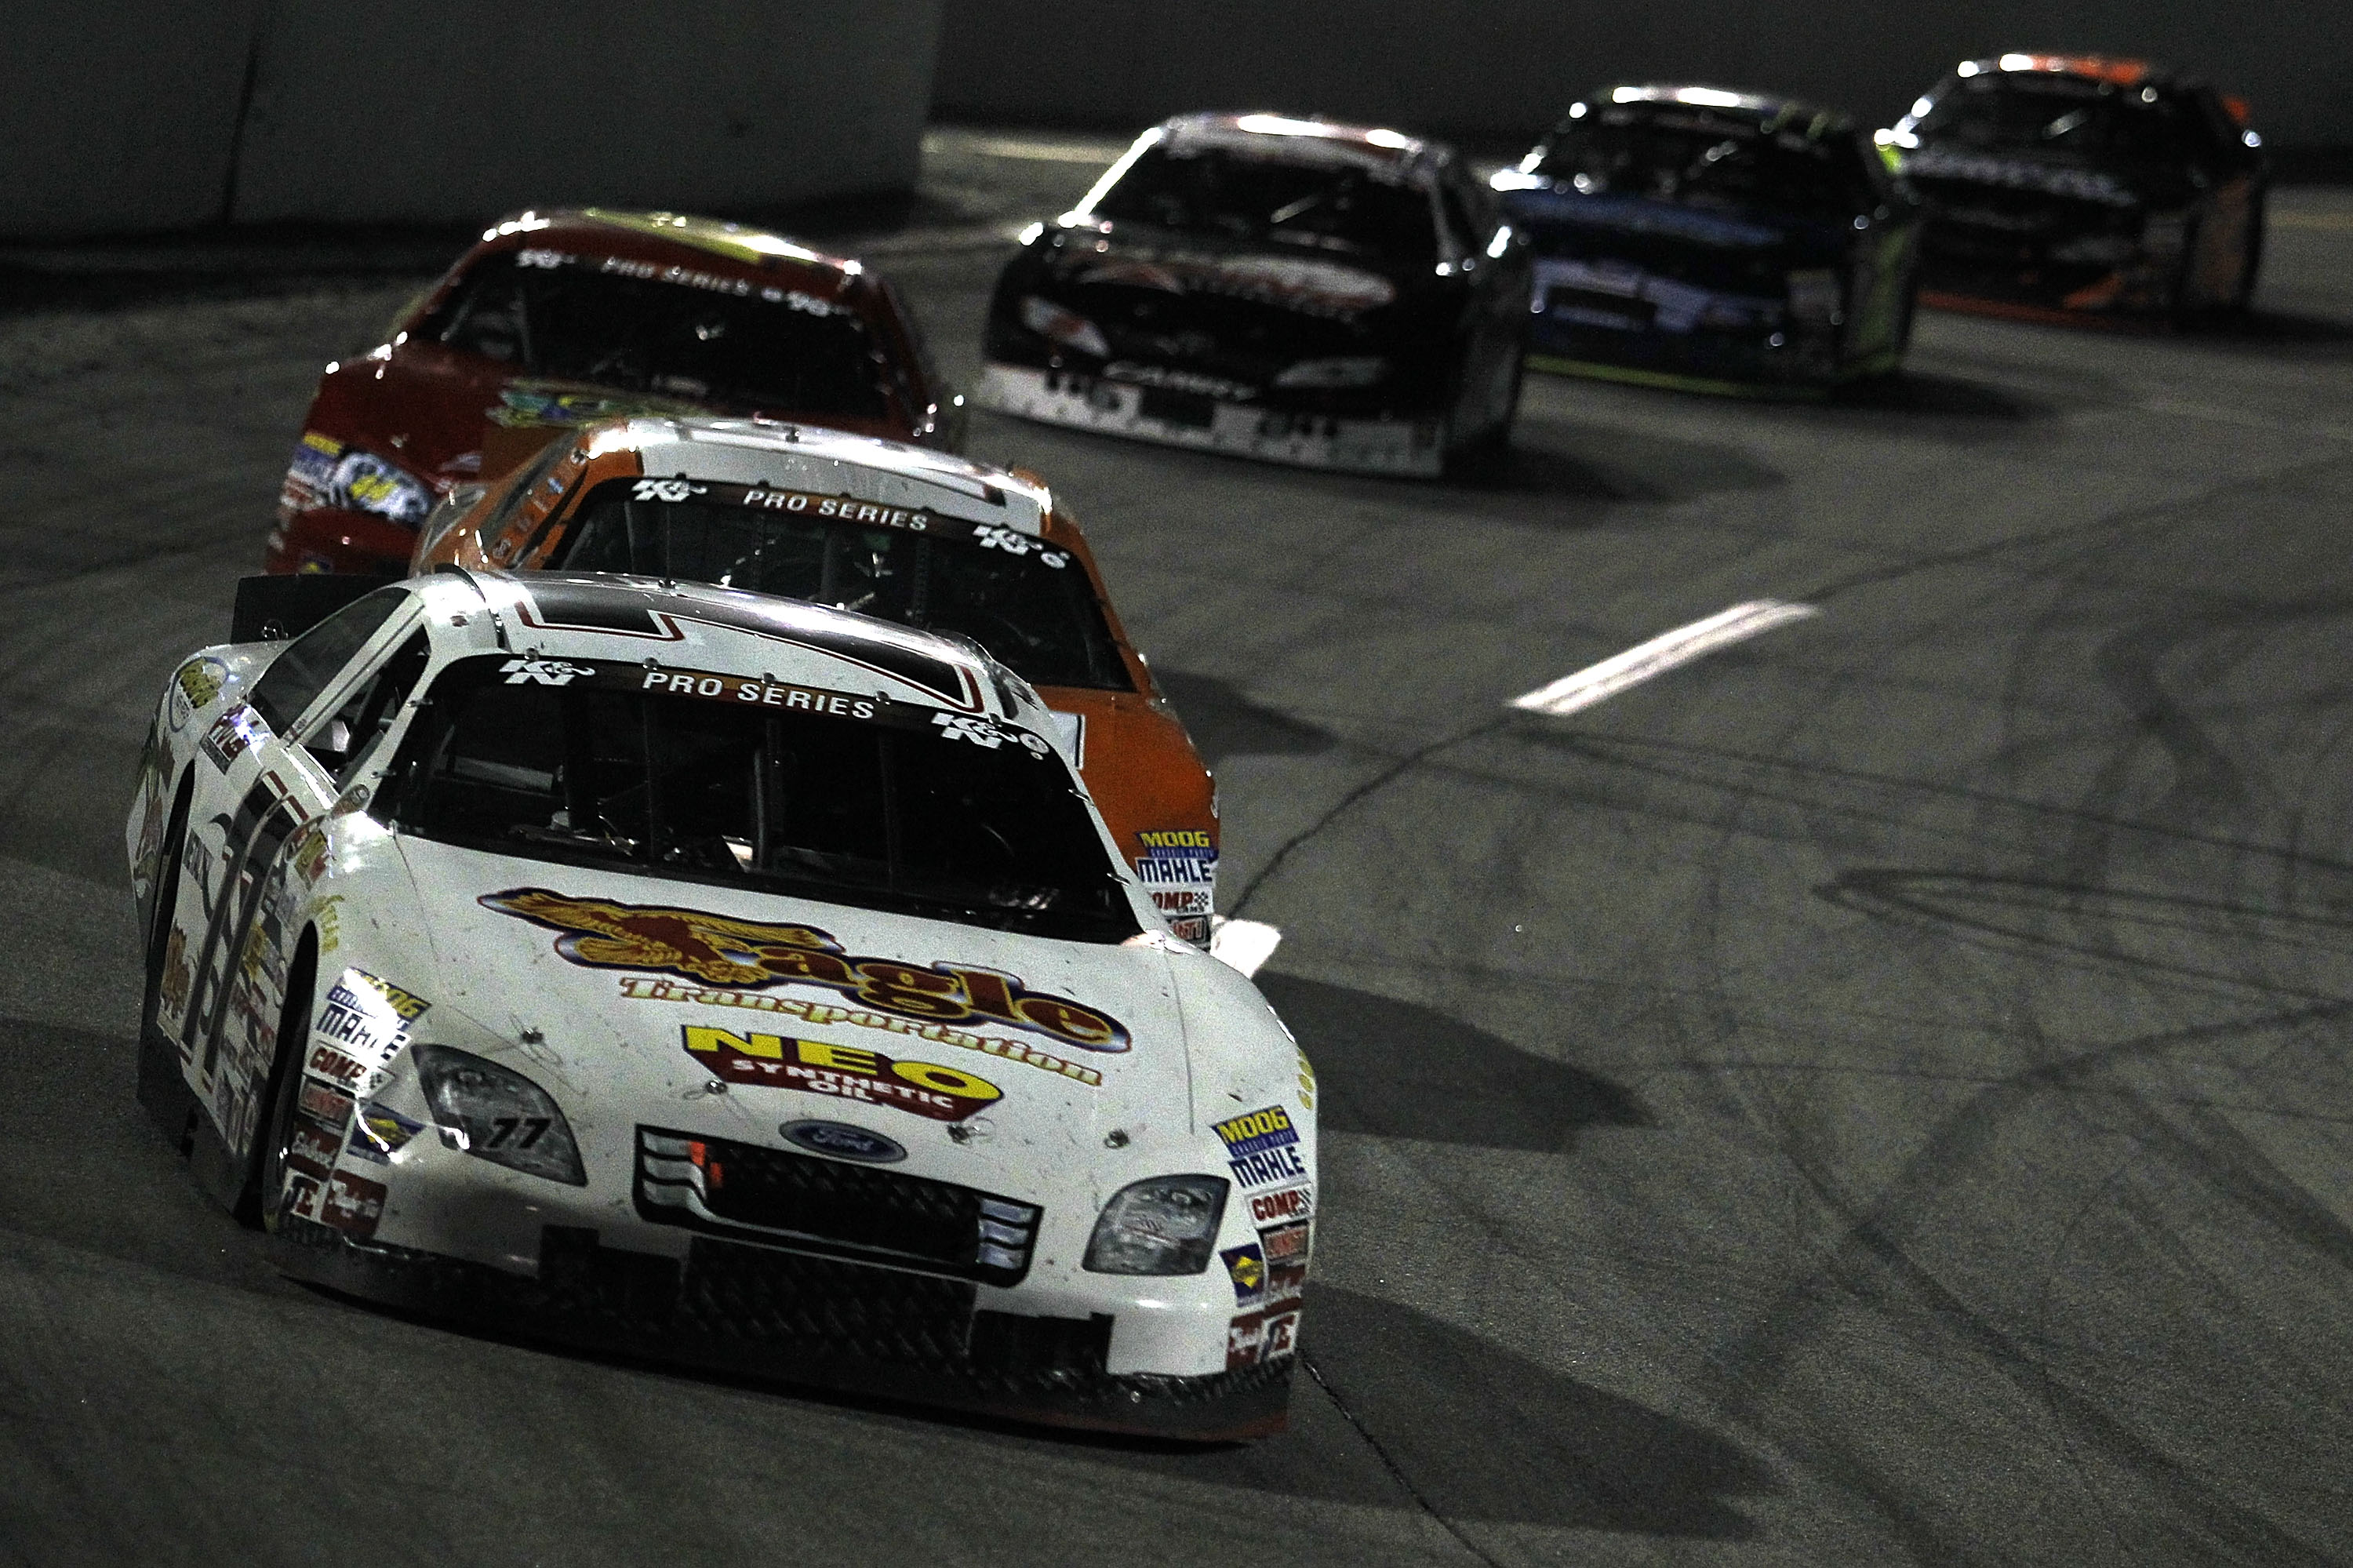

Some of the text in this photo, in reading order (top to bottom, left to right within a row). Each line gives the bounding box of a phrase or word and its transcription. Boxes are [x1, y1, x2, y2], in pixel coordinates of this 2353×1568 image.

[662, 265, 749, 297] SERIES
[743, 489, 929, 533] PRO SERIES
[642, 671, 876, 721] PRO SERIES
[1140, 831, 1210, 849] MOOG
[1136, 858, 1213, 883] MAHLE
[1151, 890, 1195, 911] OMP
[619, 977, 1103, 1086] Transportation
[310, 1047, 367, 1078] COMP
[684, 1025, 1002, 1100] NEO
[731, 1059, 955, 1109] SYNTHETIC
[807, 1079, 875, 1102] OIL
[488, 1118, 551, 1148] 77
[1218, 1107, 1289, 1144] MOOG
[1228, 1145, 1307, 1188] MAHLE
[1251, 1189, 1300, 1221] COMP
